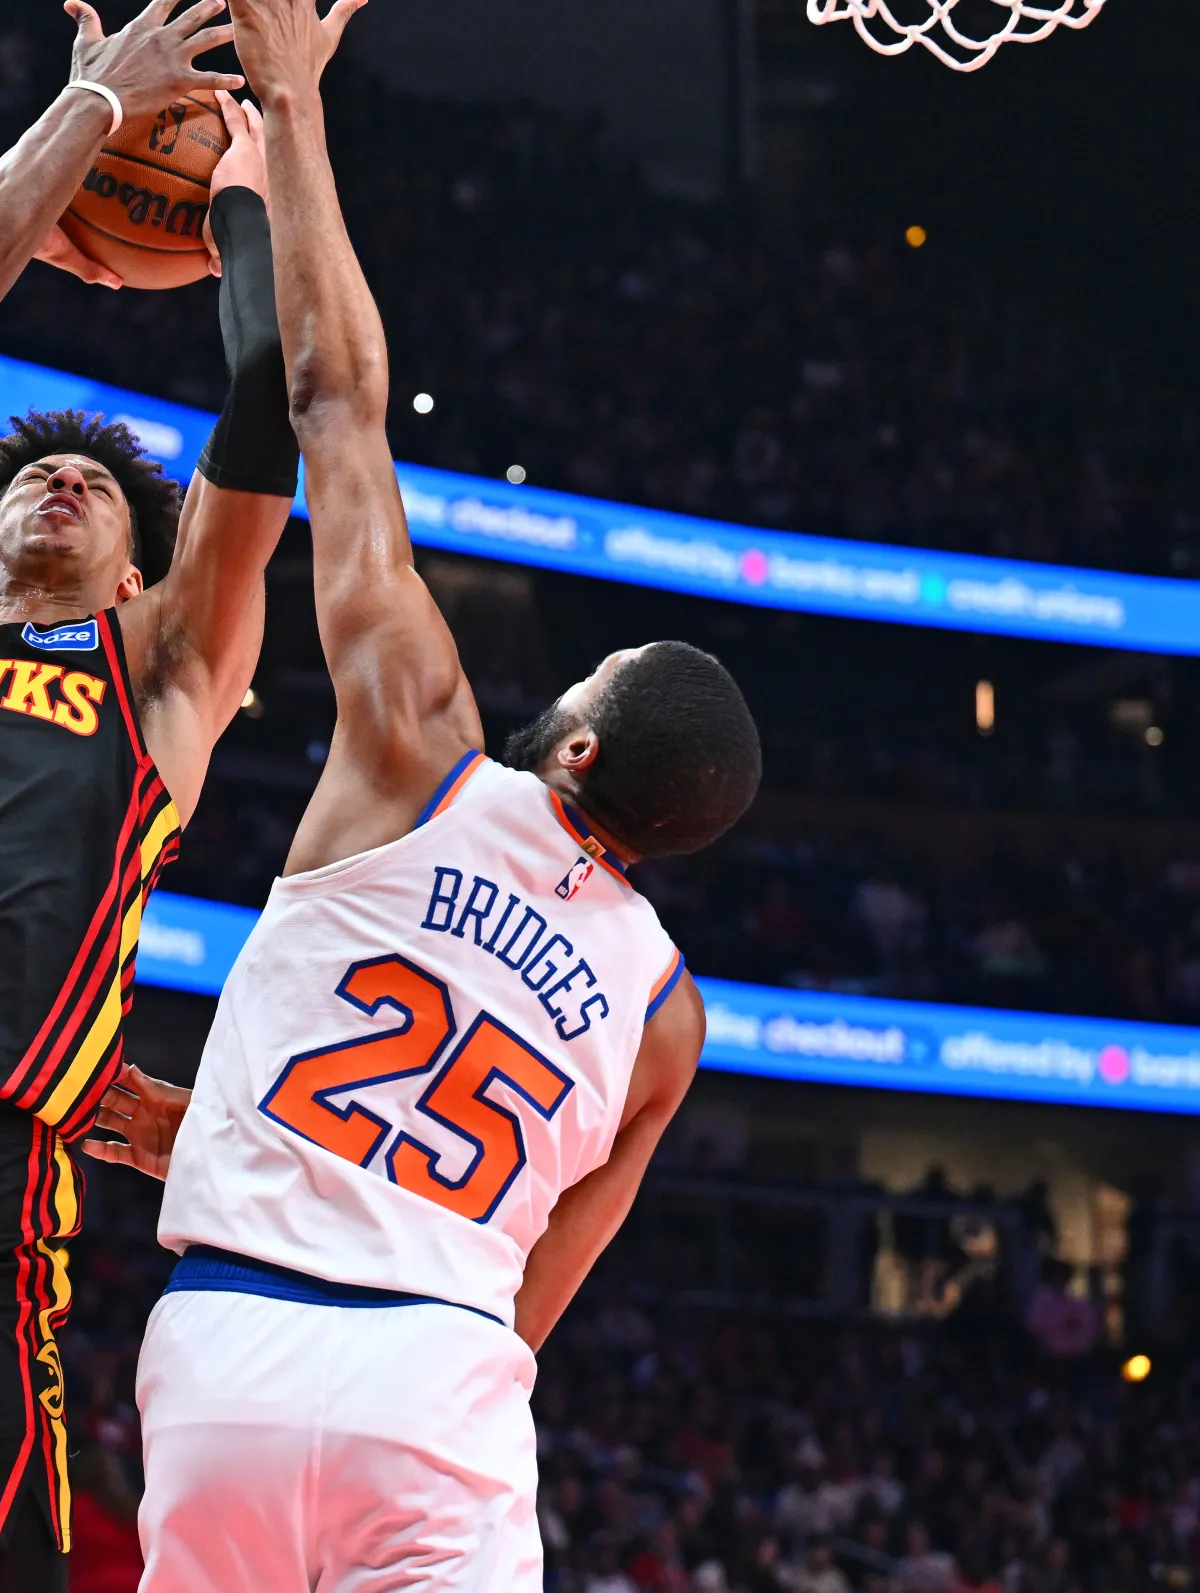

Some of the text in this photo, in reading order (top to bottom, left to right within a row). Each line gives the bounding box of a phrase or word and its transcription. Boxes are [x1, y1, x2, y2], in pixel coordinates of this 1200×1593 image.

[28, 631, 91, 644] paze
[421, 866, 609, 1041] BRIDGES
[257, 953, 575, 1225] 25
